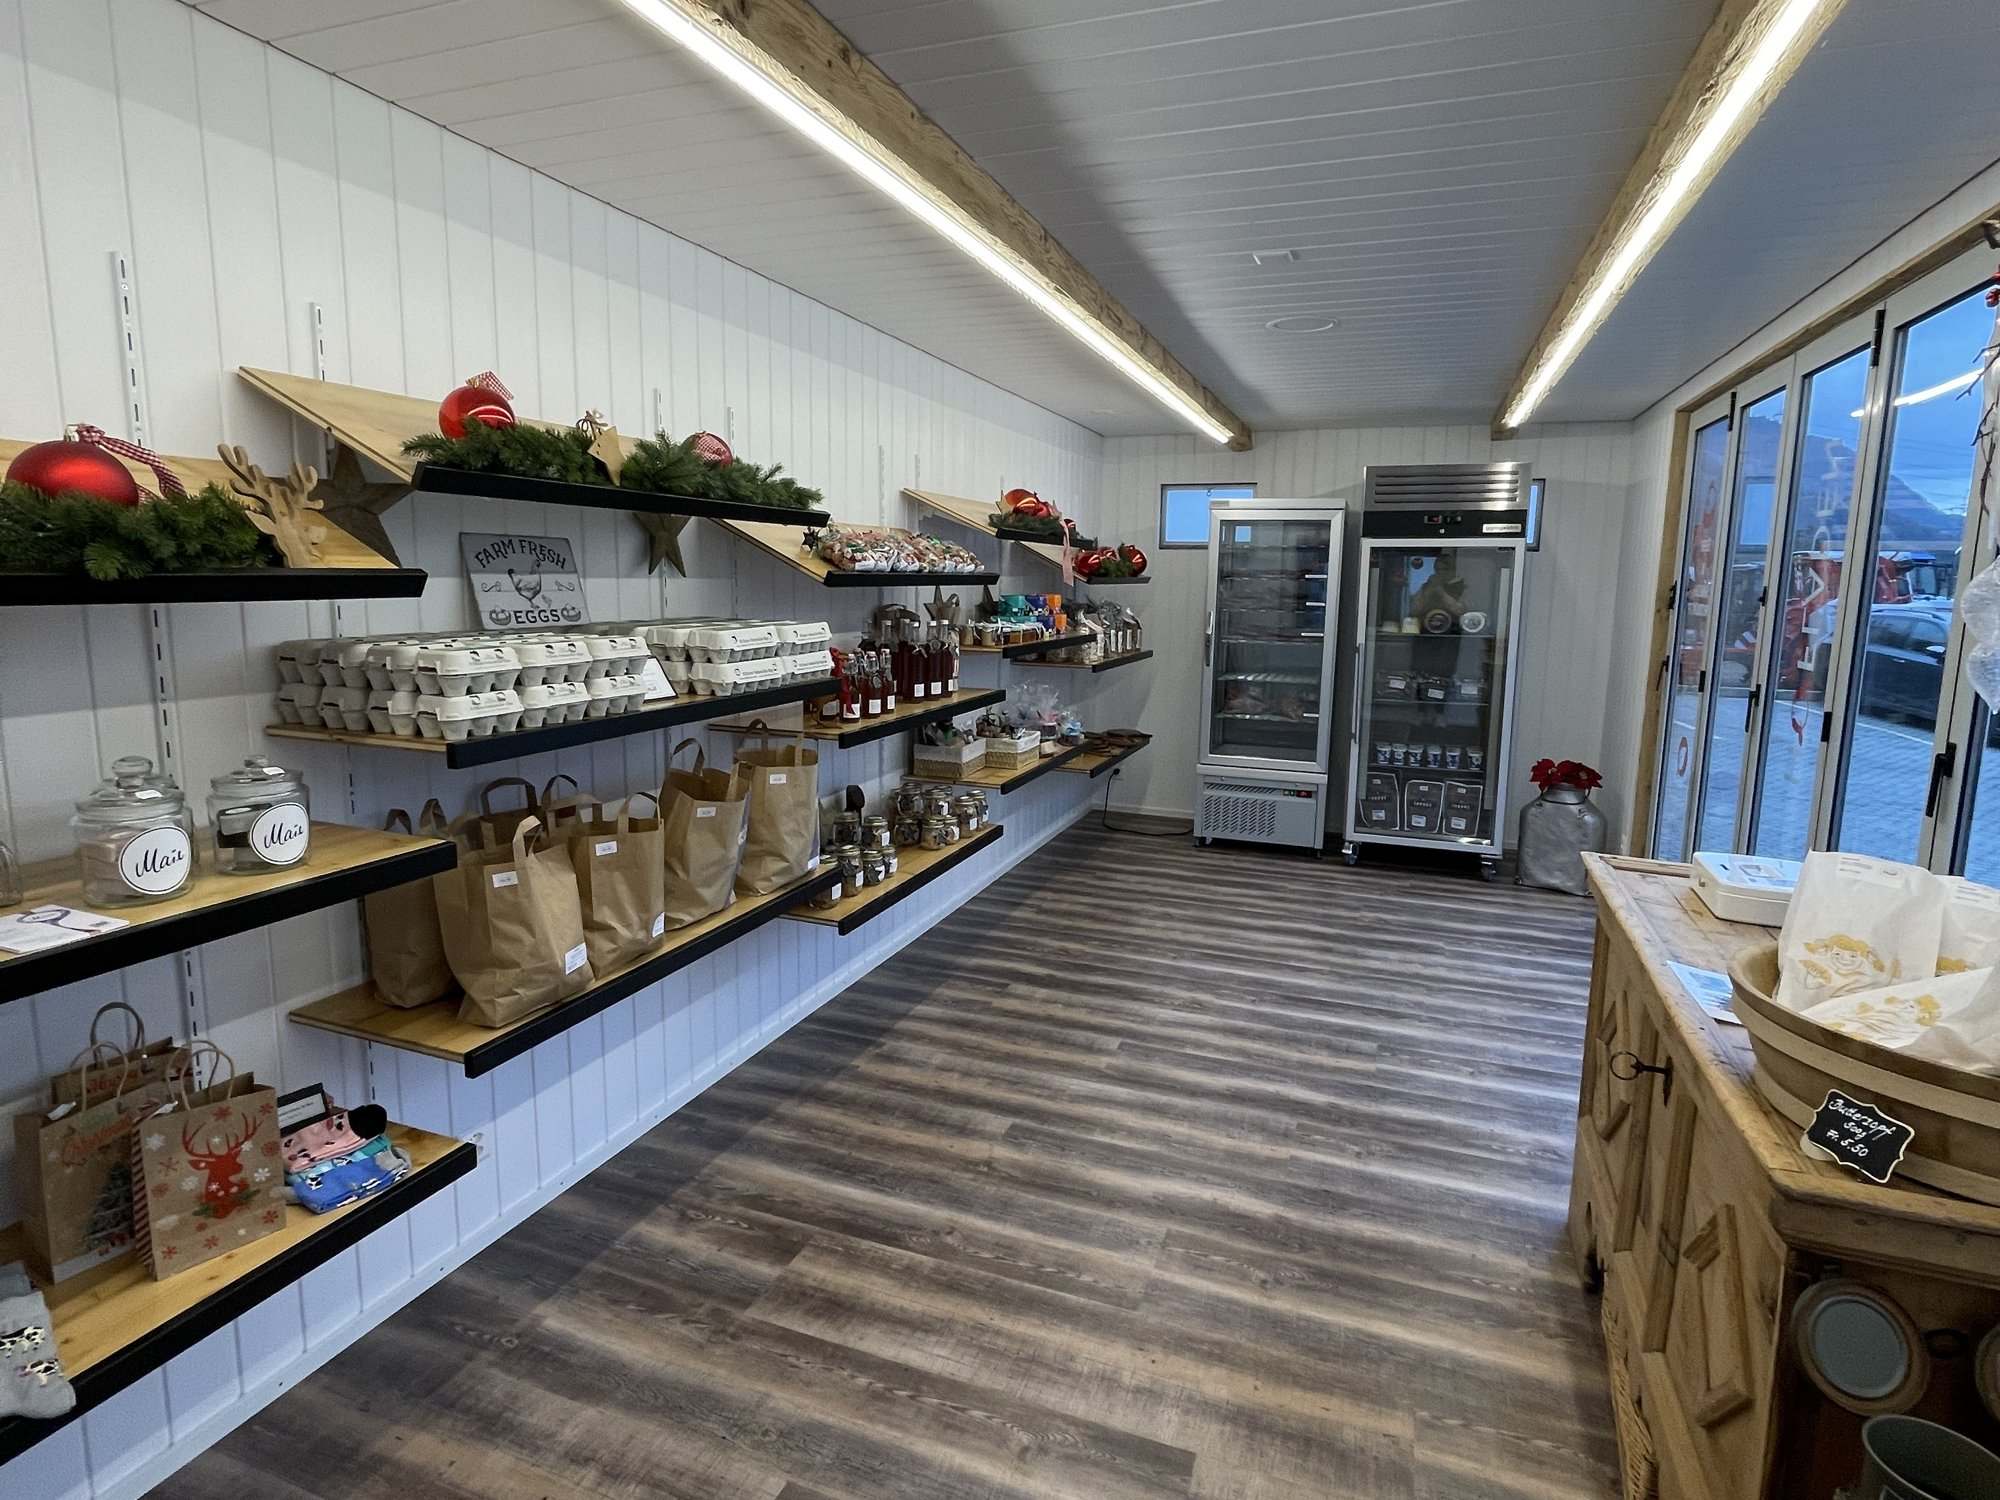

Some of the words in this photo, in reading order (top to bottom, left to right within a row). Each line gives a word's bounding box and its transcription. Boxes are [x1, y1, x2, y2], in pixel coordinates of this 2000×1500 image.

[475, 539, 516, 569] FARM
[518, 539, 567, 569] FRESH
[513, 609, 561, 625] EGGS
[1843, 1121, 1868, 1141] 500g
[1840, 1138, 1869, 1157] 5.50
